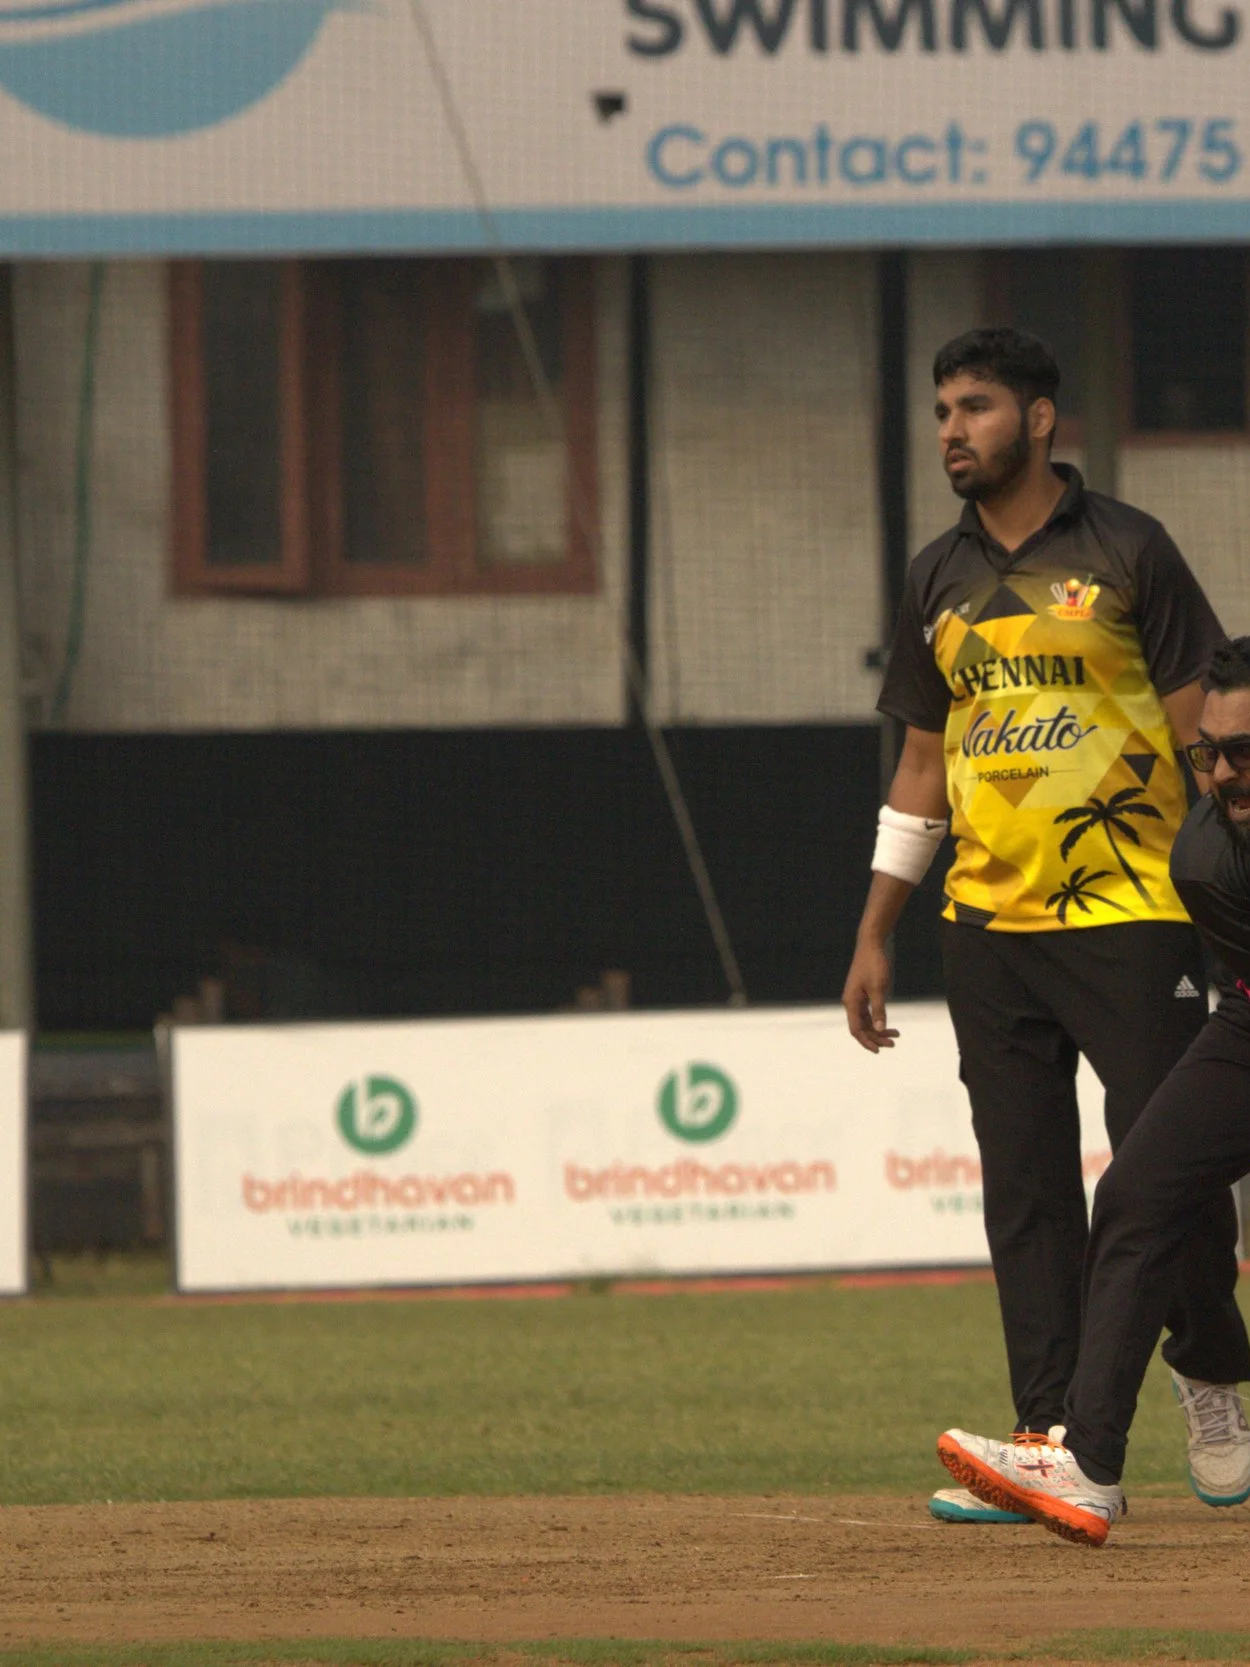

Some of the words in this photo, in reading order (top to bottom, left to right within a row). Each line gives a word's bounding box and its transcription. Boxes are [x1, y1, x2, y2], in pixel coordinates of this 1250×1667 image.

[625, 0, 1240, 57] SWIMMING
[645, 120, 988, 190] Contact:
[1015, 116, 1241, 184] 94475
[950, 654, 1086, 702] CHENNAI
[977, 766, 1050, 783] PORCELAIN
[240, 1168, 517, 1214] brindhavan
[561, 1157, 838, 1203] brindhavan
